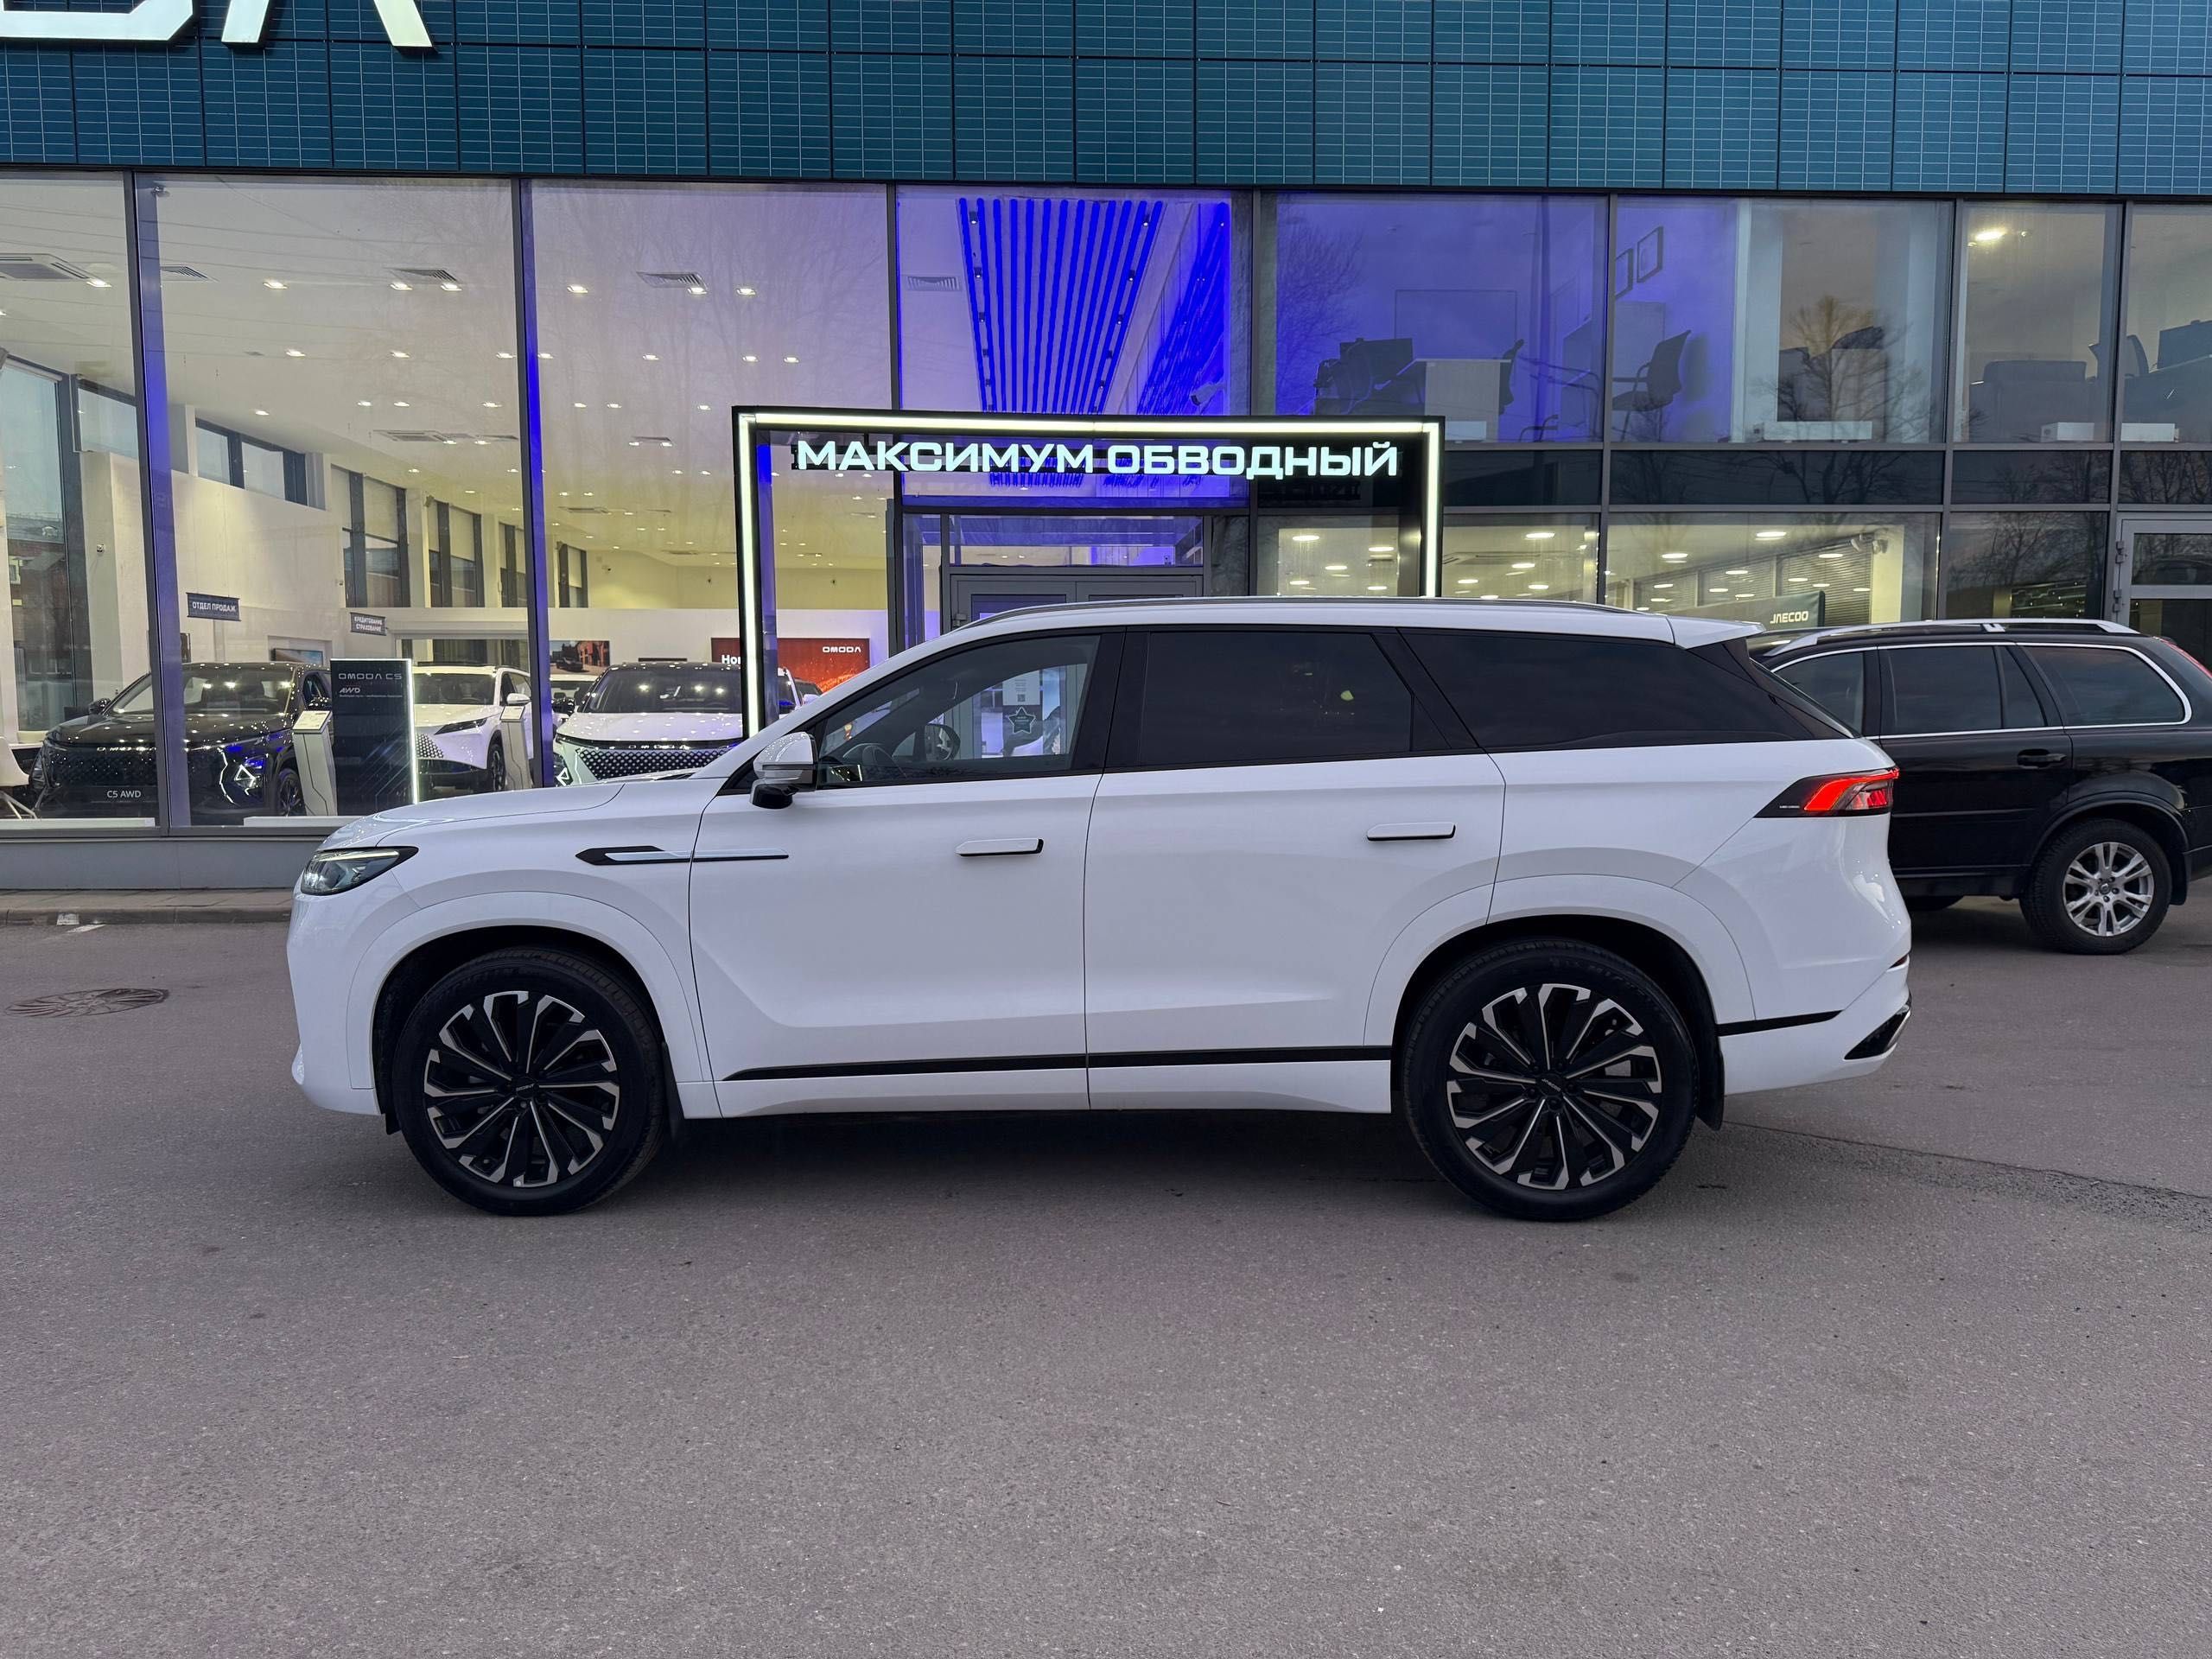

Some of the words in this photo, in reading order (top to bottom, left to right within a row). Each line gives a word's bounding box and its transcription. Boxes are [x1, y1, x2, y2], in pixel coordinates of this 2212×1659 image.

[798, 440, 1093, 473] МАКСИМУМ
[1108, 442, 1397, 480] ОБВОДНЫЙ
[192, 601, 211, 610] ОТДЕЛ
[212, 603, 236, 613] ПРОДАЖ
[1770, 611, 1808, 624] JAECOO
[106, 790, 118, 798] C5
[120, 790, 142, 798] AWD
